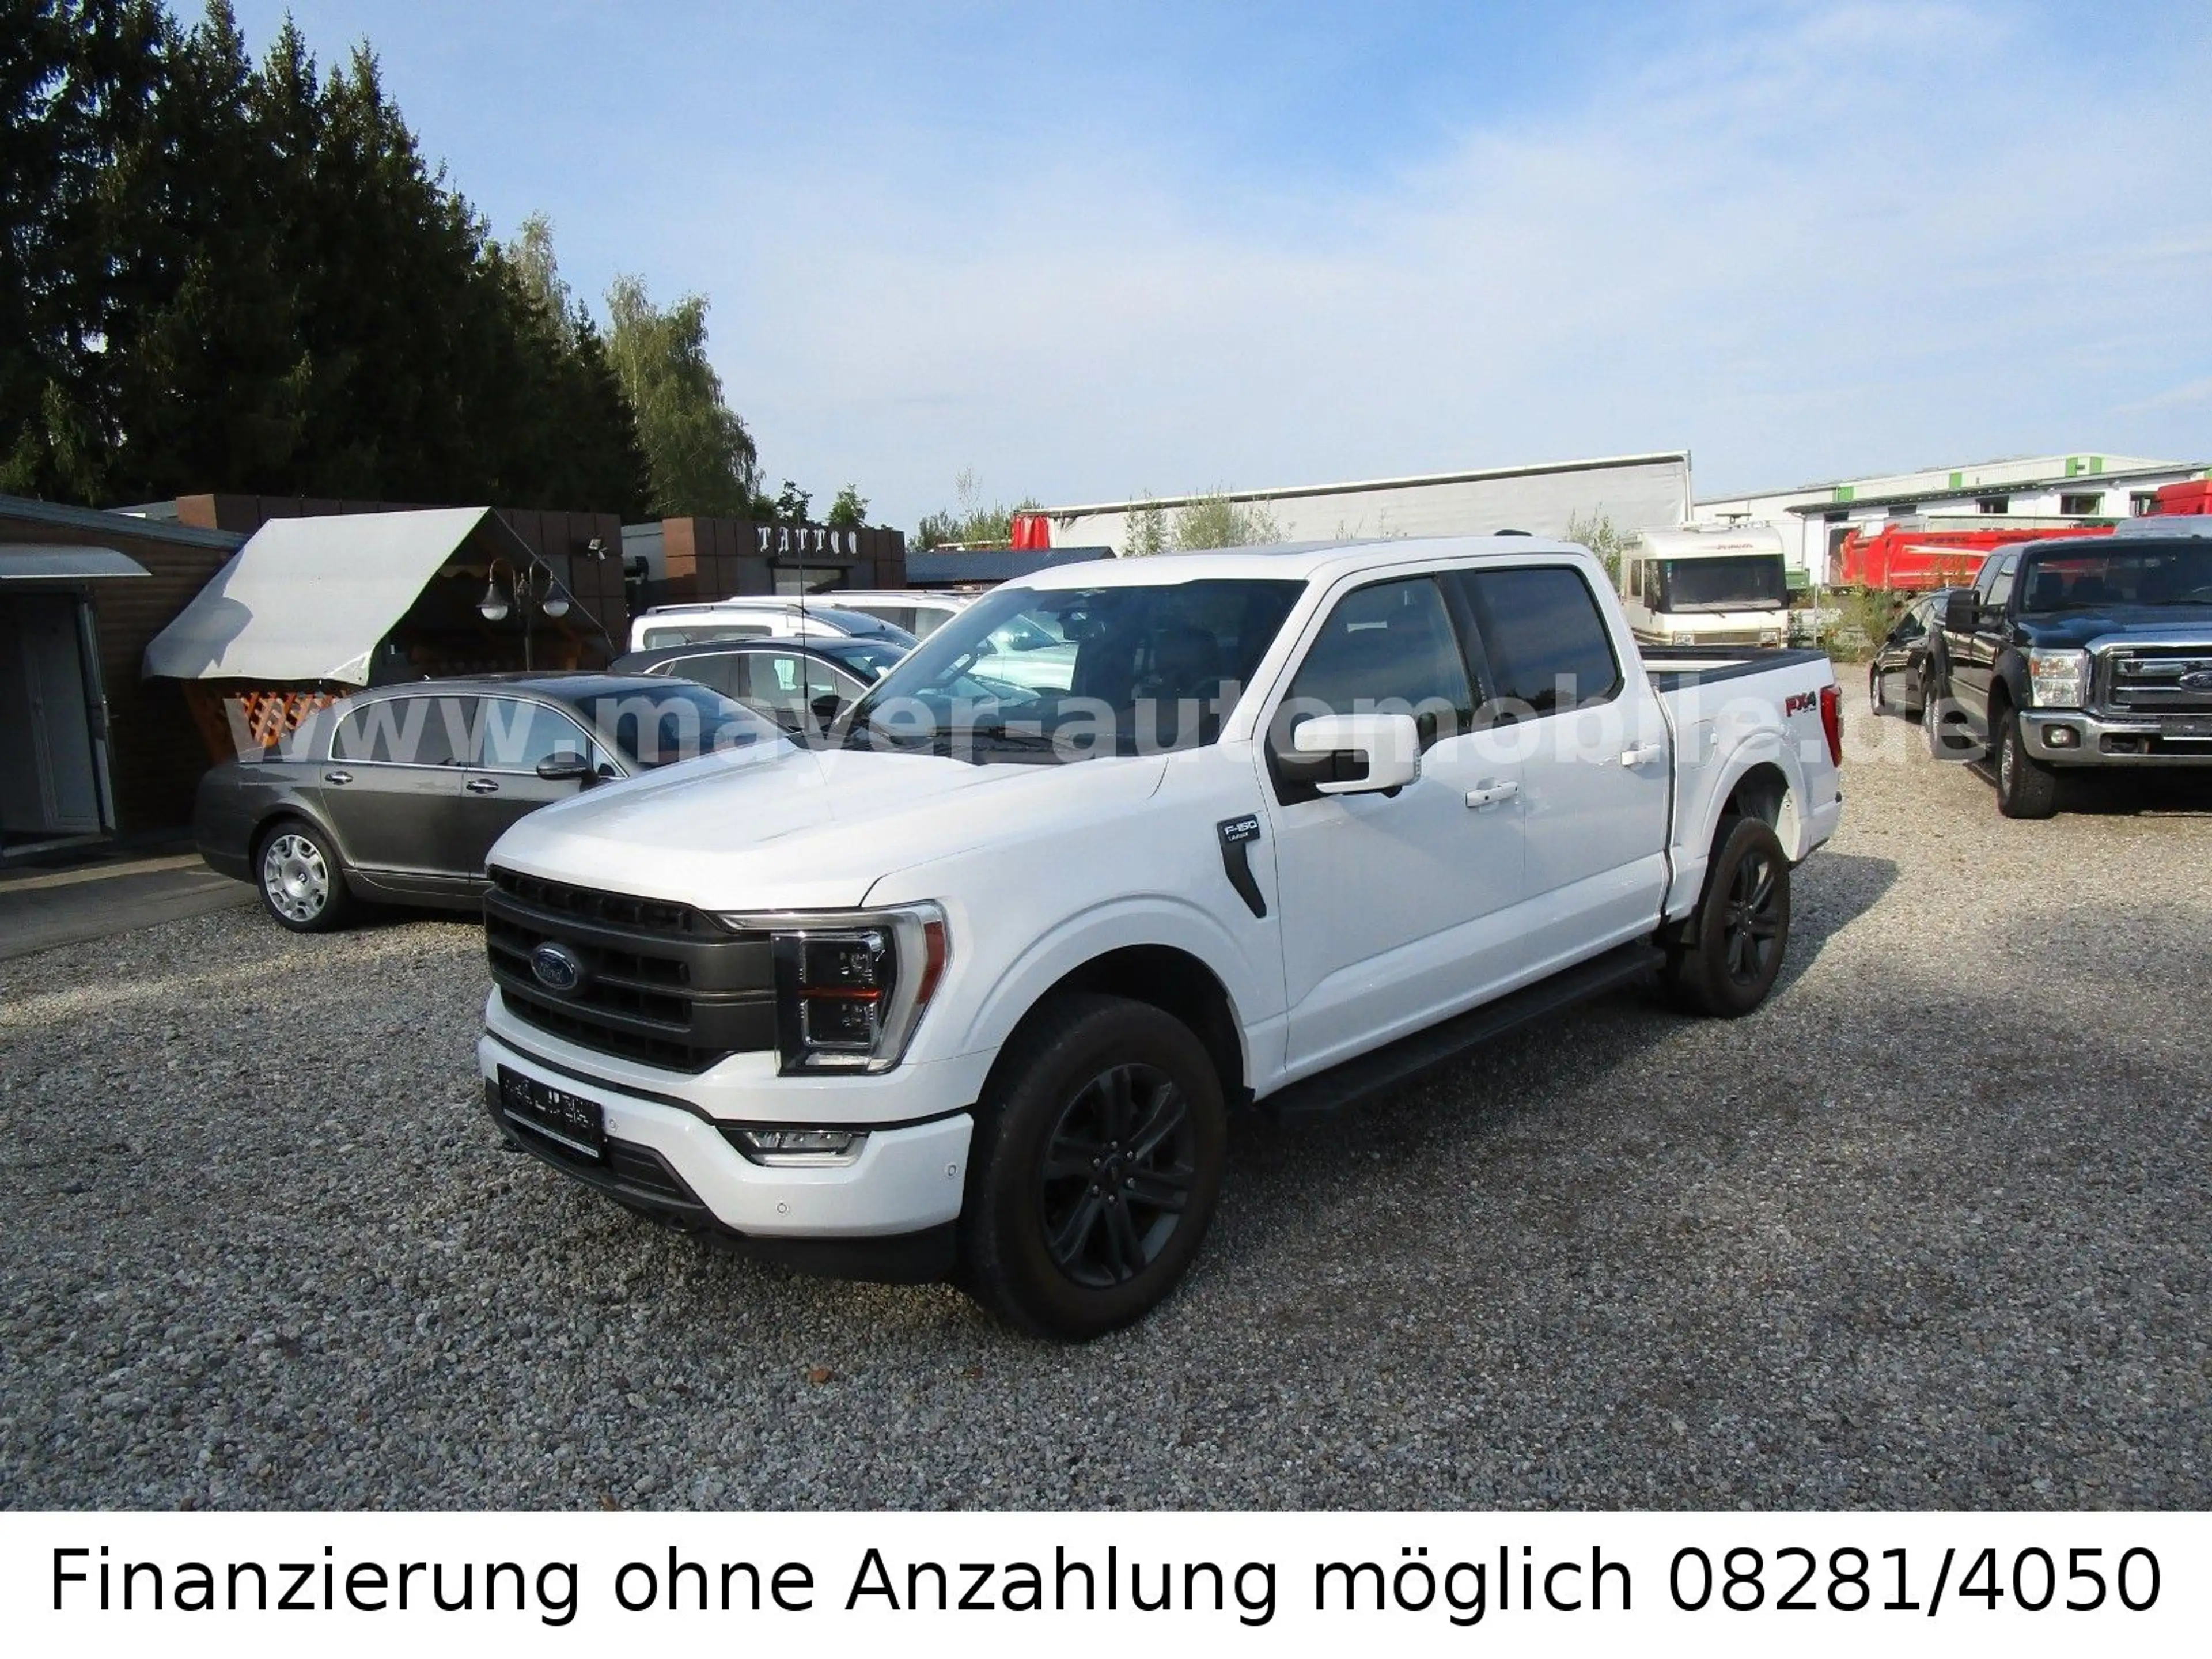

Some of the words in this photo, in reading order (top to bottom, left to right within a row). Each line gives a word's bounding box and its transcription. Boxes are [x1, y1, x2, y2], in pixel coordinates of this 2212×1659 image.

[757, 527, 857, 554] TATTOO
[1785, 691, 1816, 717] FX4
[1224, 820, 1258, 835] F-150
